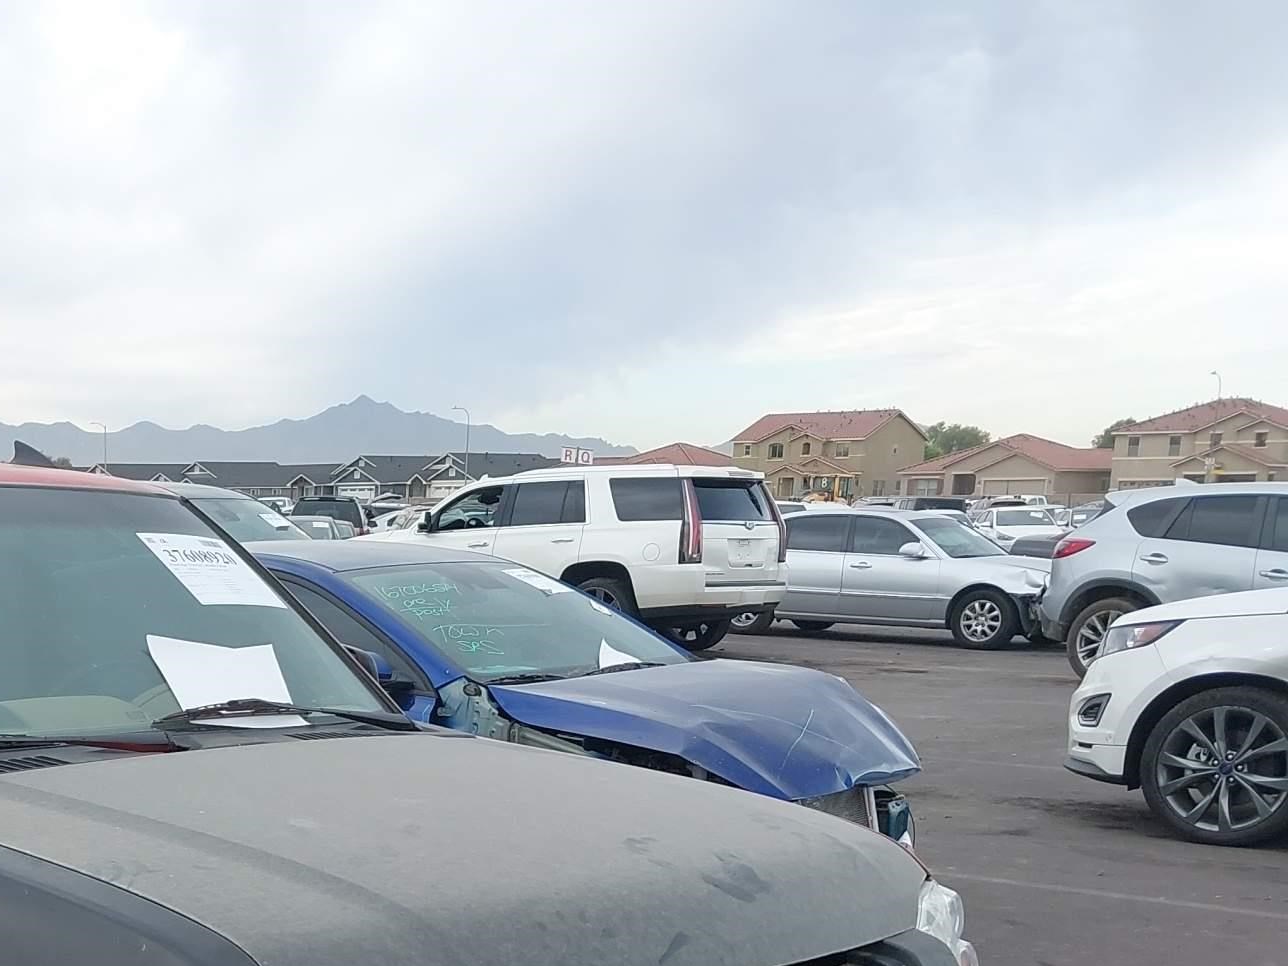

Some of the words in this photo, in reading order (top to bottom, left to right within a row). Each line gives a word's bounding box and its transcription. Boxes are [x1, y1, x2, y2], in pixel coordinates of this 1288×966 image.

[564, 449, 573, 462] R
[581, 450, 591, 464] Q
[162, 548, 238, 566] 37608920
